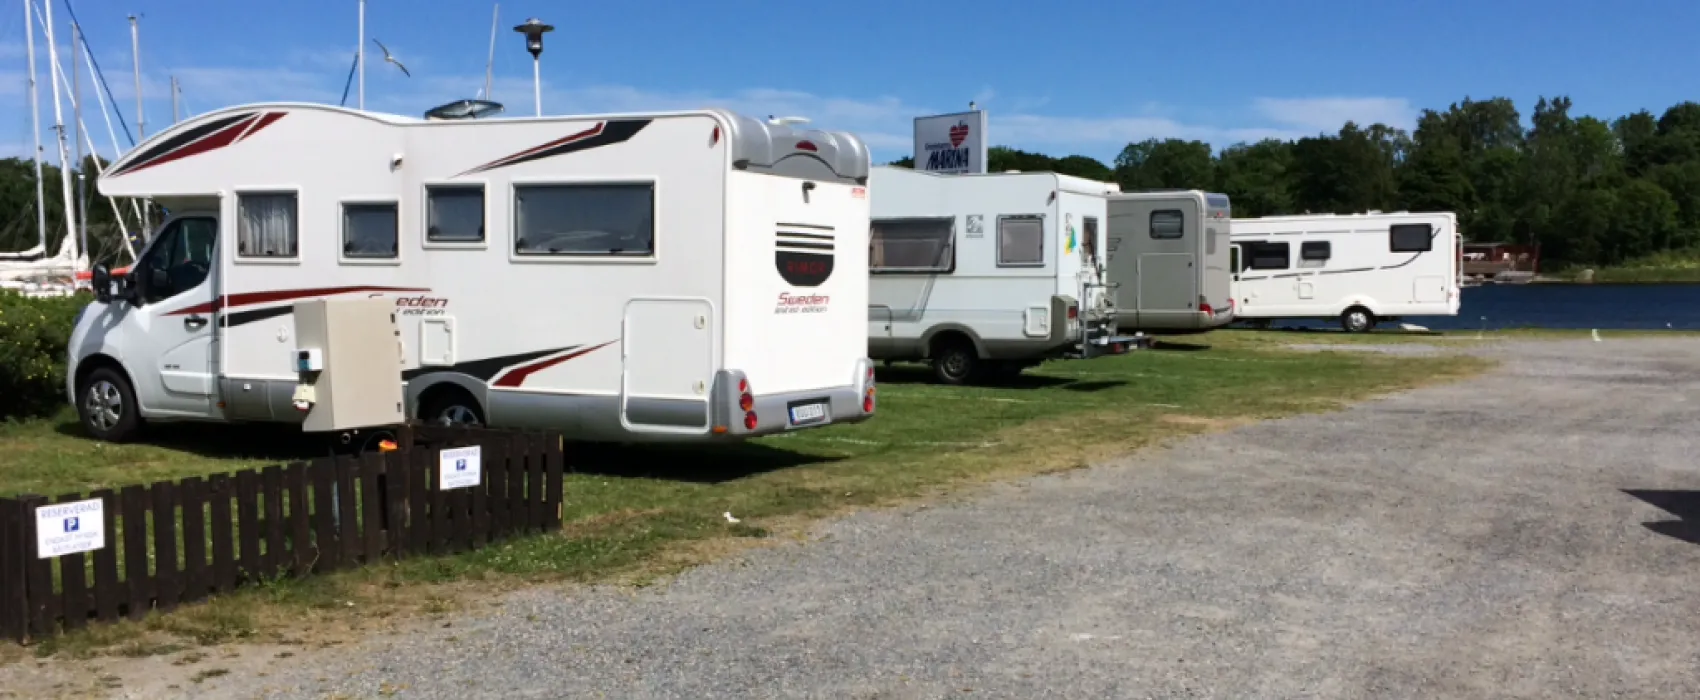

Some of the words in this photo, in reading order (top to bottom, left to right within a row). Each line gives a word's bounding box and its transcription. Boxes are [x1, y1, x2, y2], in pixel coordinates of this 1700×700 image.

[926, 148, 969, 170] MARINA
[396, 295, 449, 307] eden
[777, 291, 830, 306] Sweden
[402, 308, 446, 316] edition
